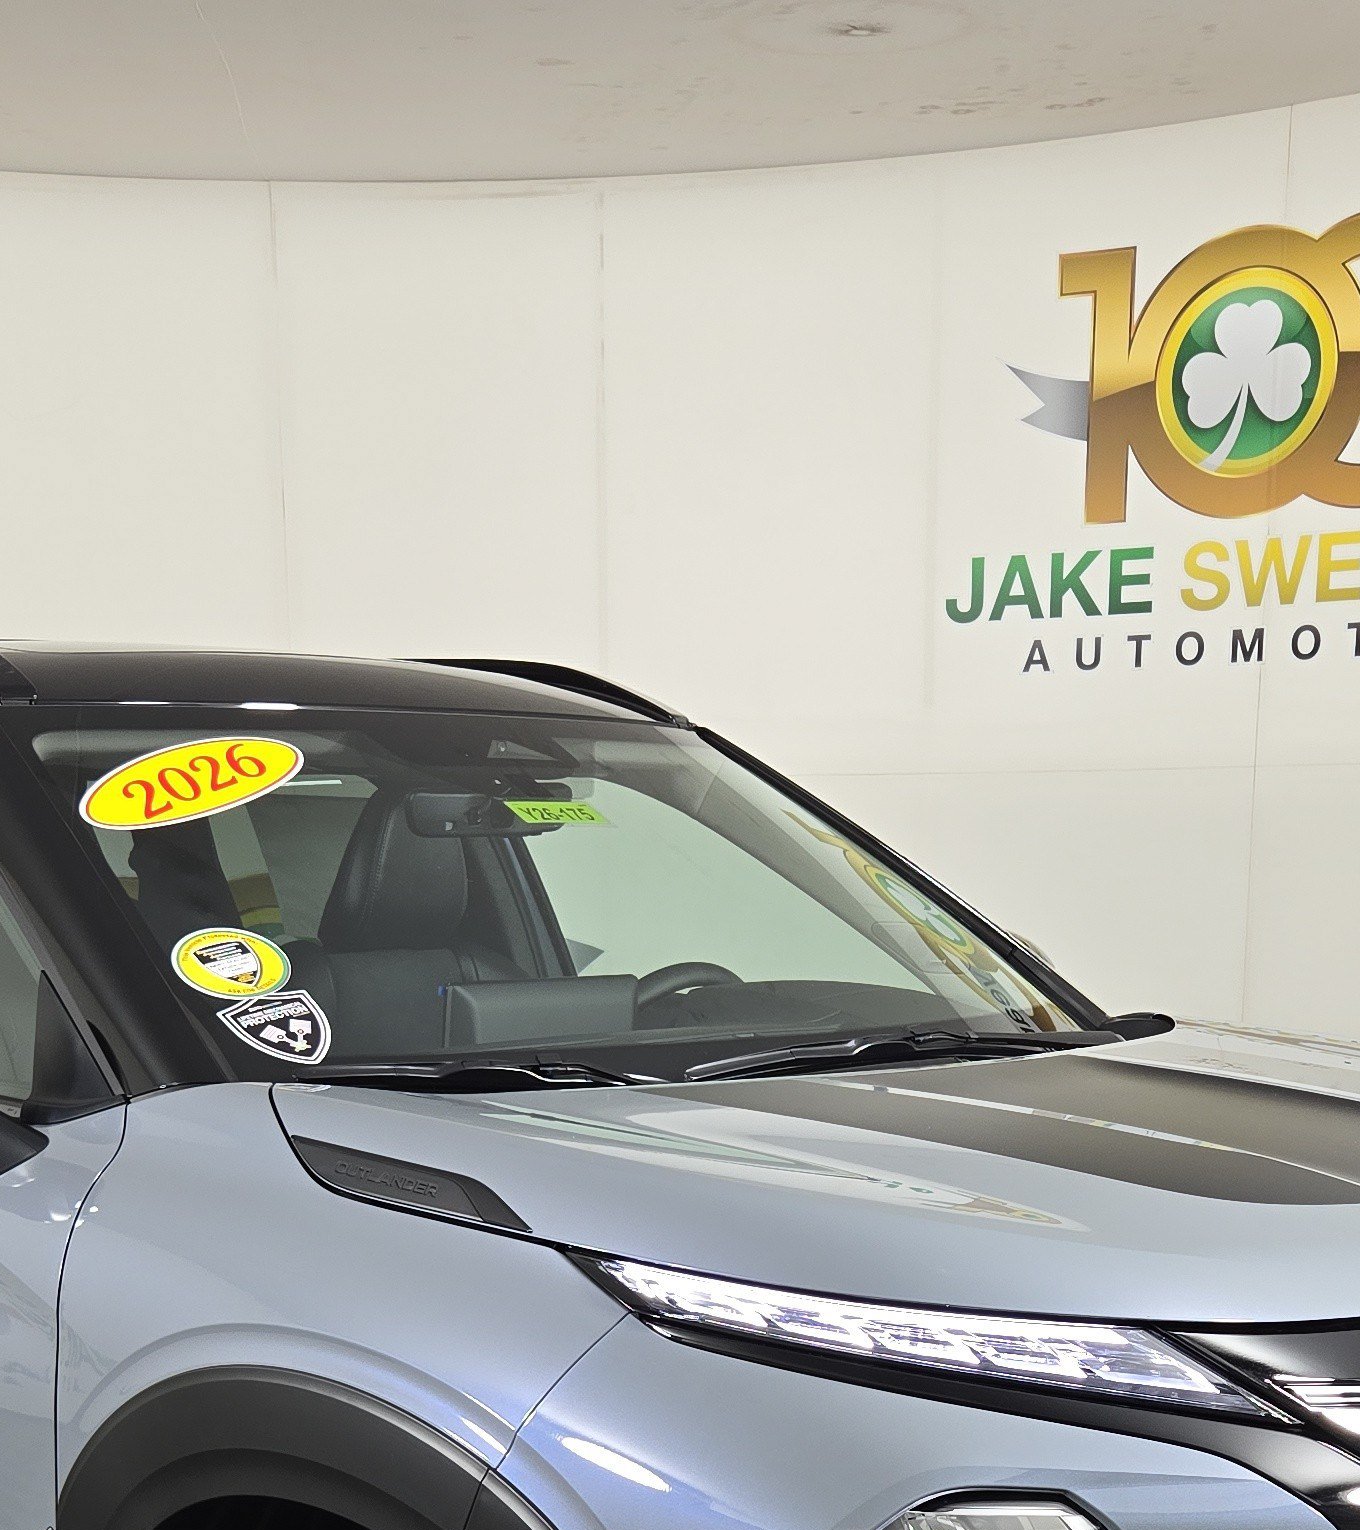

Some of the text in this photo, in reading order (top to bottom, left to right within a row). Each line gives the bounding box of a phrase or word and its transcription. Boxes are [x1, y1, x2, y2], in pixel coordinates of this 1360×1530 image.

[944, 546, 1155, 623] JAKE
[121, 743, 267, 820] 2026
[517, 807, 595, 821] Y26-175
[240, 1005, 310, 1029] PROTECTION
